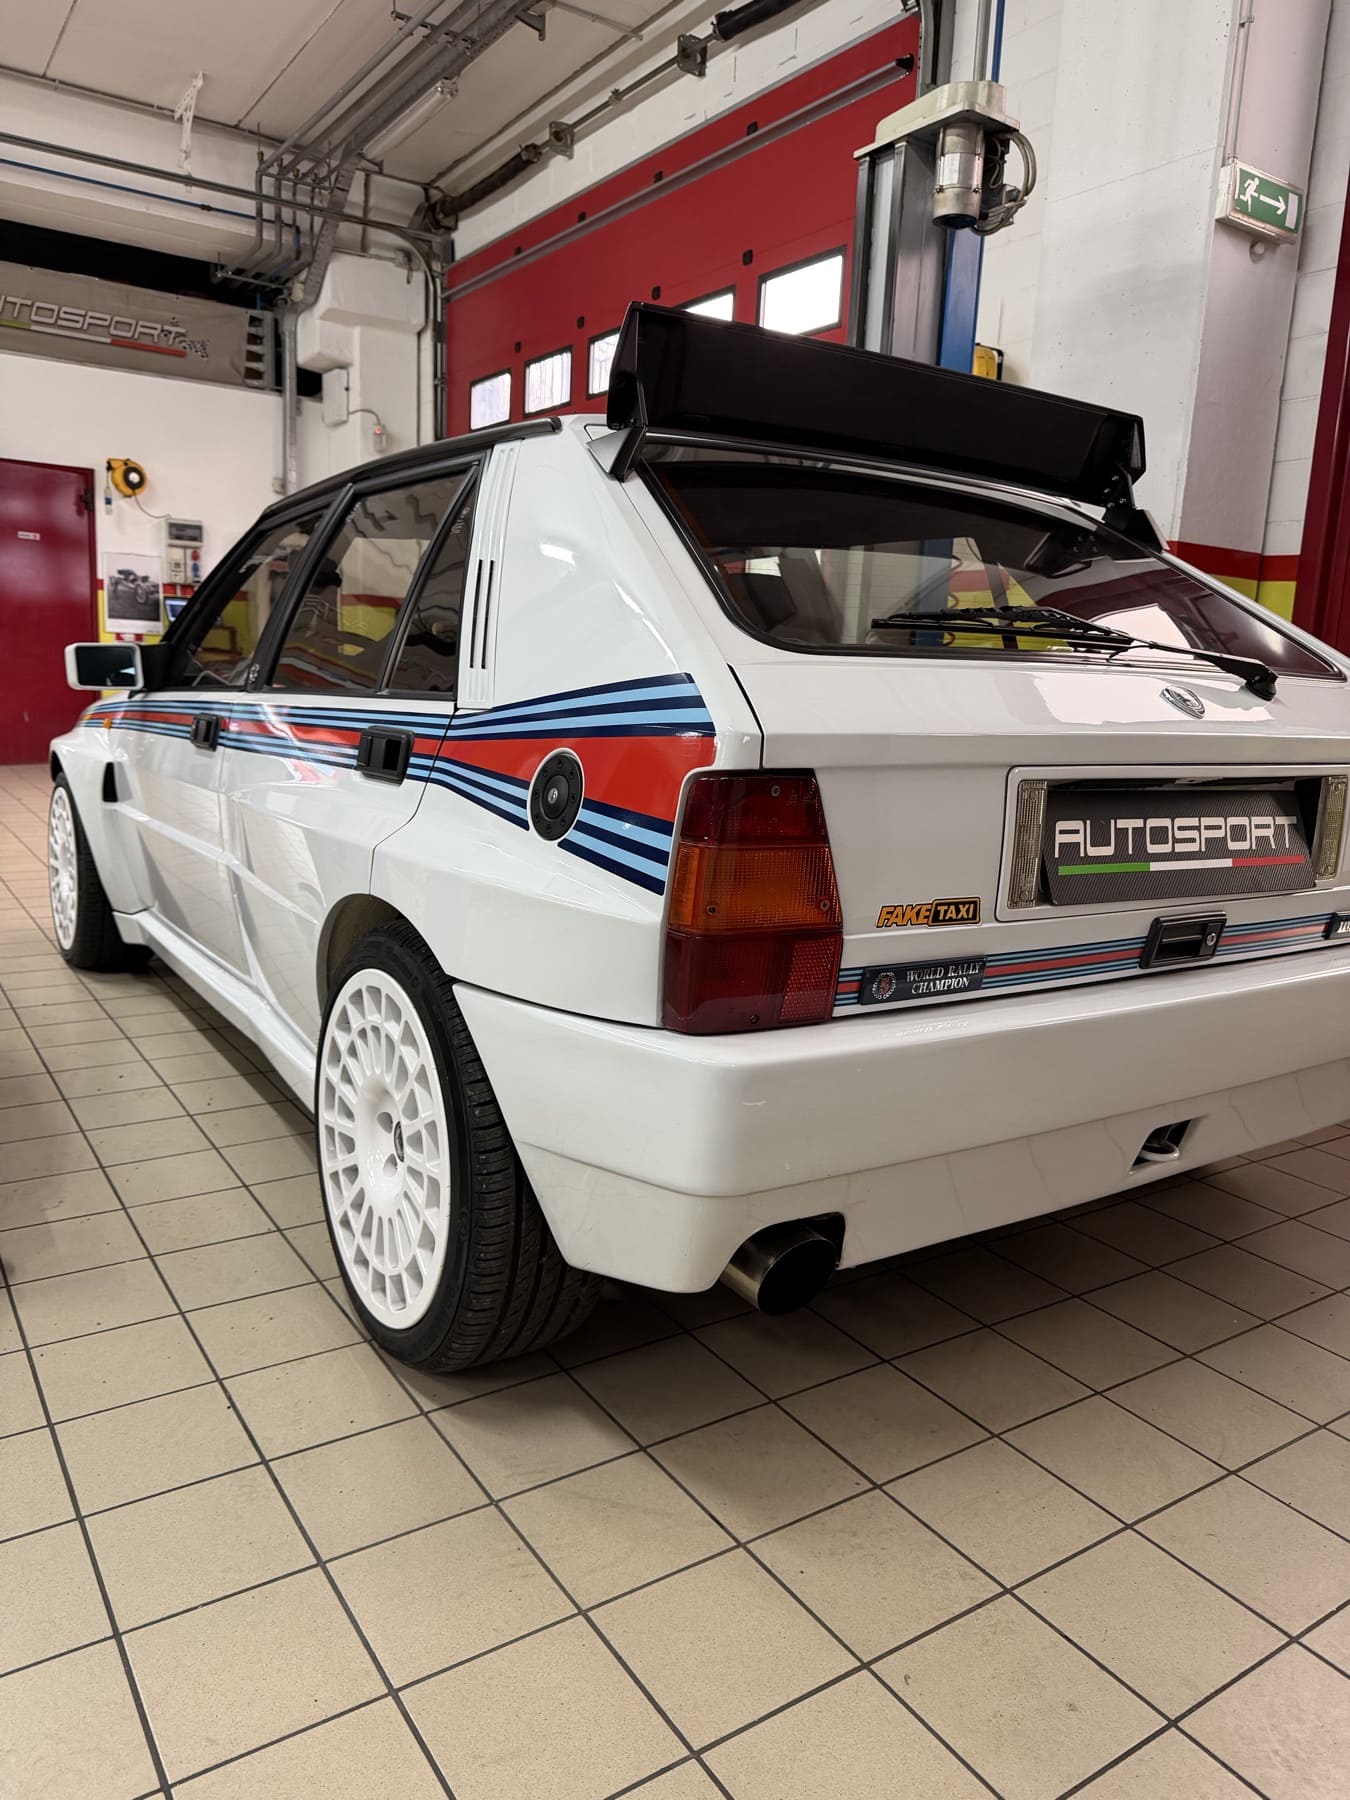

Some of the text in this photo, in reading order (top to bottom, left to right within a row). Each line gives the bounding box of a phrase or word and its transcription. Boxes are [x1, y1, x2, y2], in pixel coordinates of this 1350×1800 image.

[0, 296, 187, 344] TOSPORT
[1055, 816, 1297, 858] AUTOSPORT
[877, 904, 974, 928] FAKE TAXI
[906, 962, 982, 982] WORLD RALLY
[912, 977, 969, 994] CHAMPION
